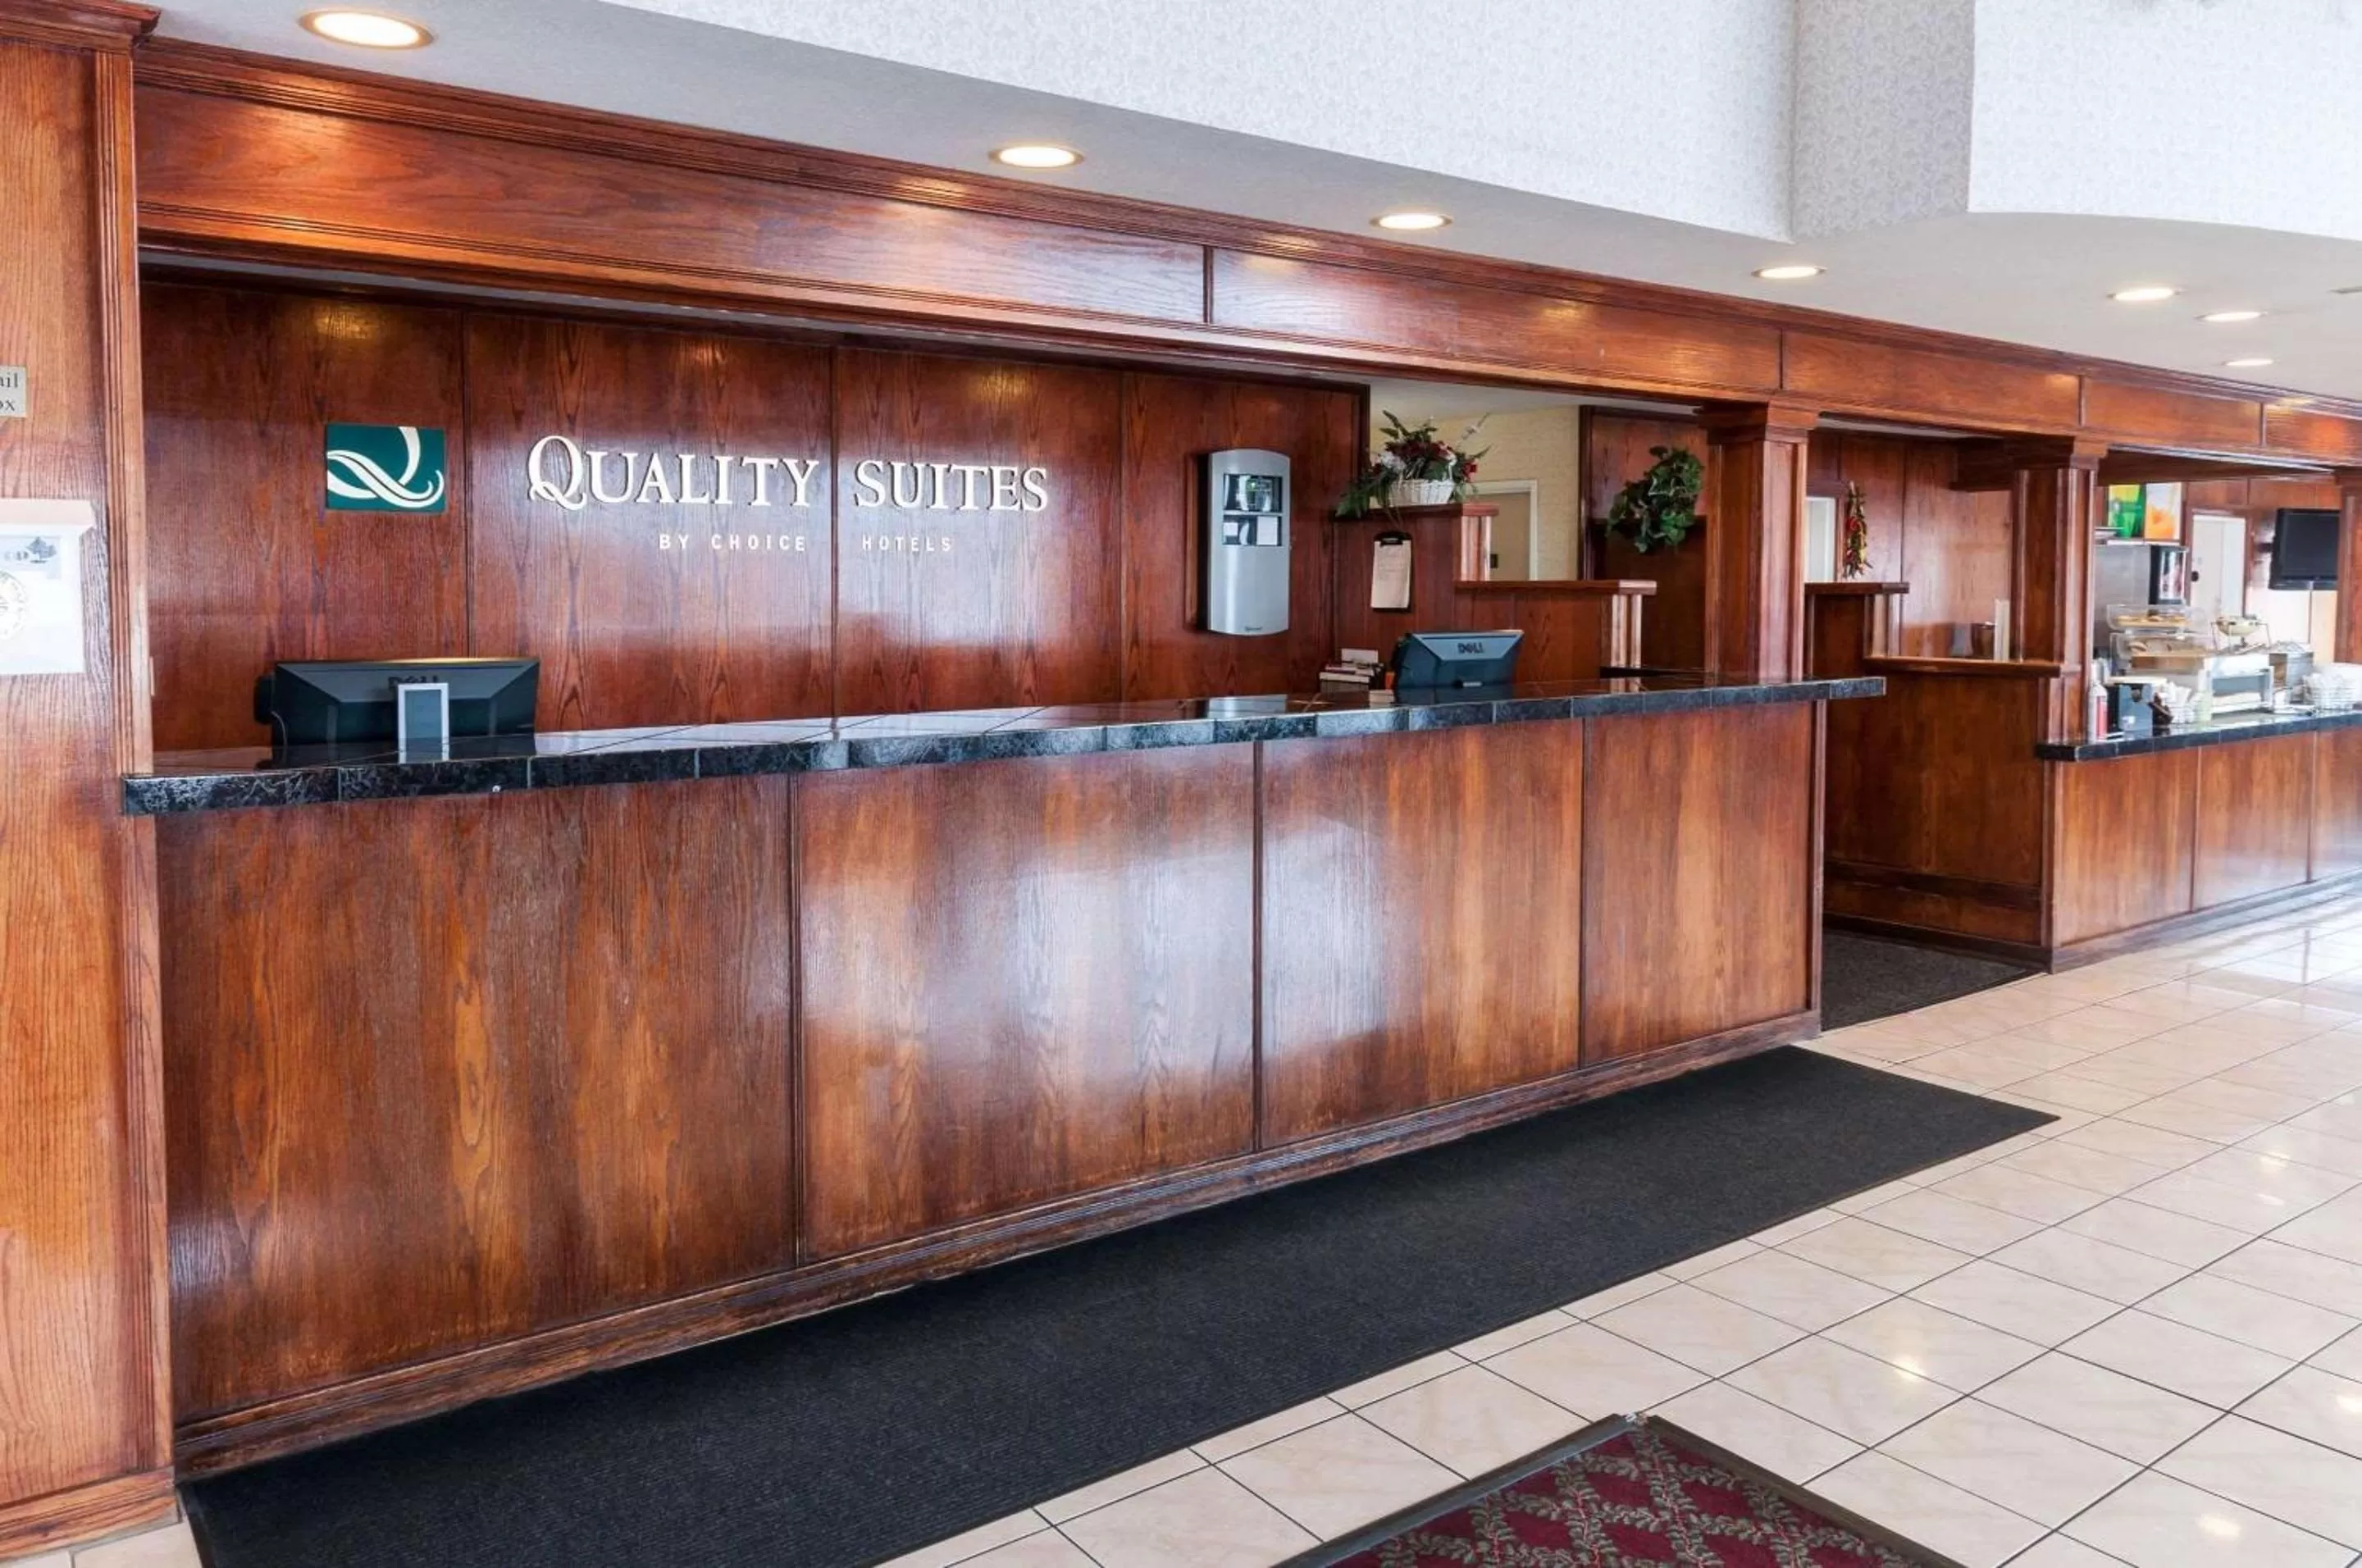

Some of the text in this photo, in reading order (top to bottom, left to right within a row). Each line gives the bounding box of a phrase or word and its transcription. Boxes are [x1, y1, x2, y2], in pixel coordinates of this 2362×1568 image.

[527, 435, 1049, 512] QUALITY SUITES
[659, 535, 952, 552] BY CHOICE HOTELS
[1457, 641, 1484, 654] DELL
